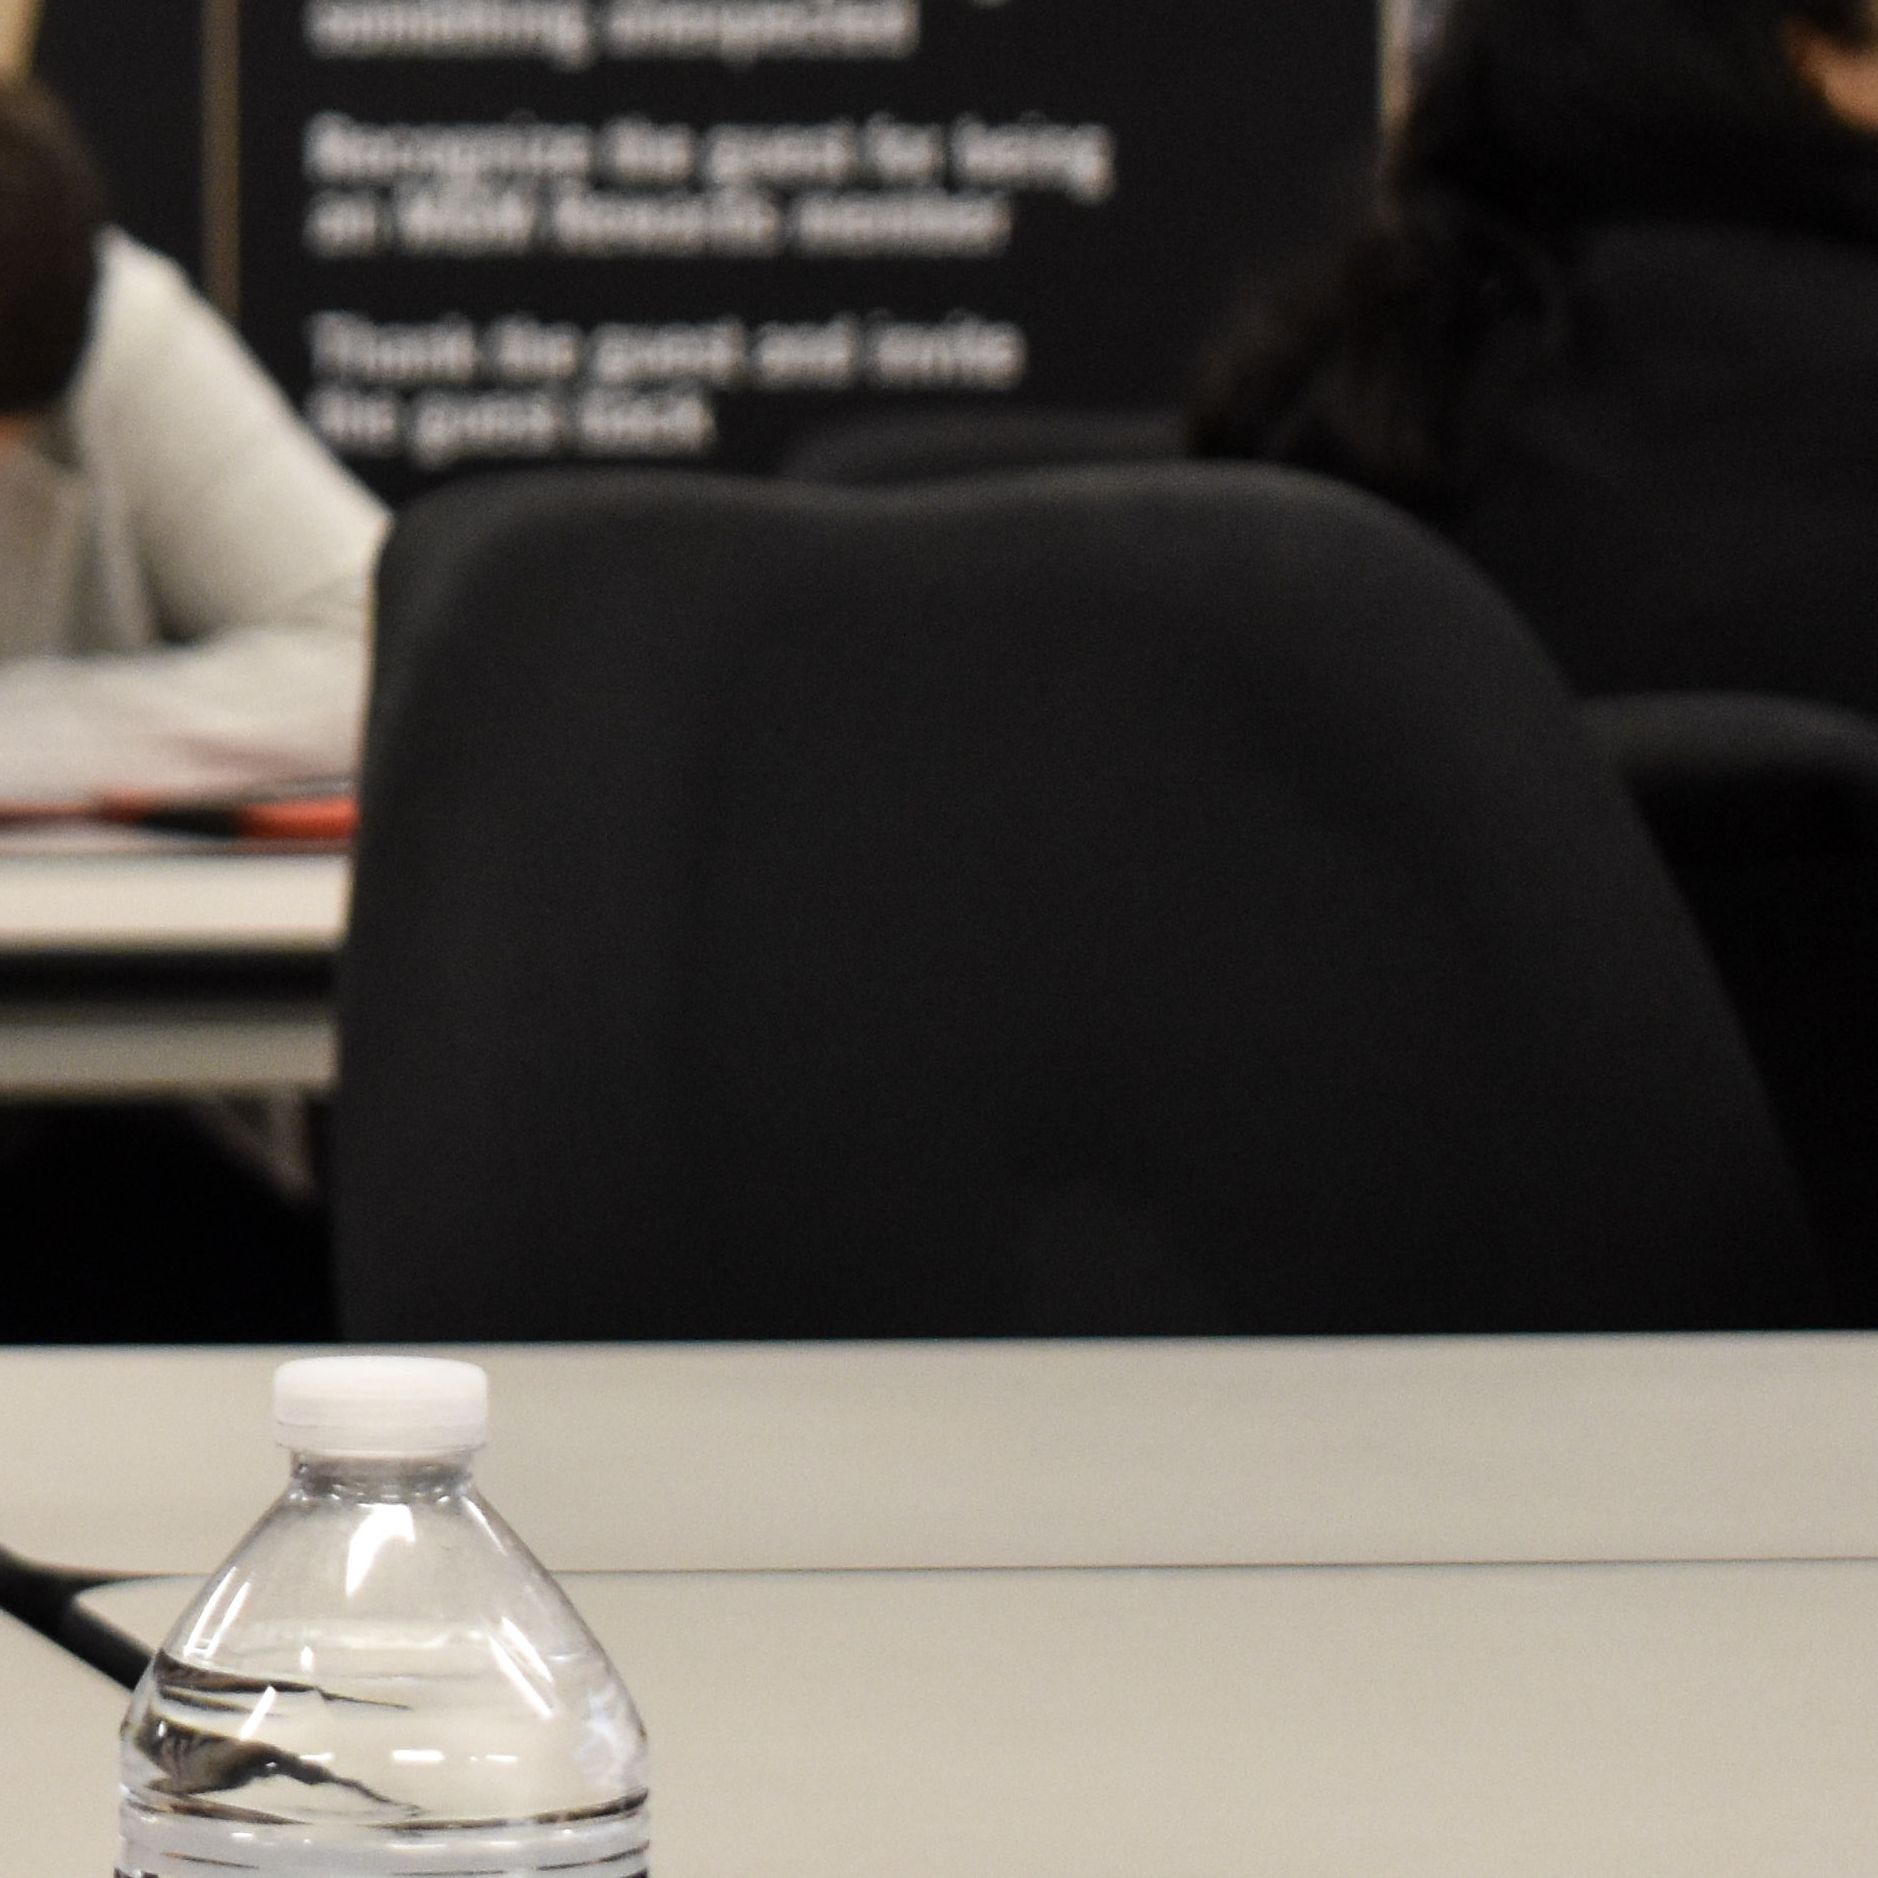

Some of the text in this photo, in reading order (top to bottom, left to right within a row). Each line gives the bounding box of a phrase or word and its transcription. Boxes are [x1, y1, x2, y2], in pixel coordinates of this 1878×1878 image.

[307, 114, 1112, 194] Recognize the guest for being
[792, 185, 1005, 249] member
[311, 313, 1020, 393] Thank the guest and invite
[310, 383, 399, 445] the
[409, 383, 567, 459] guest
